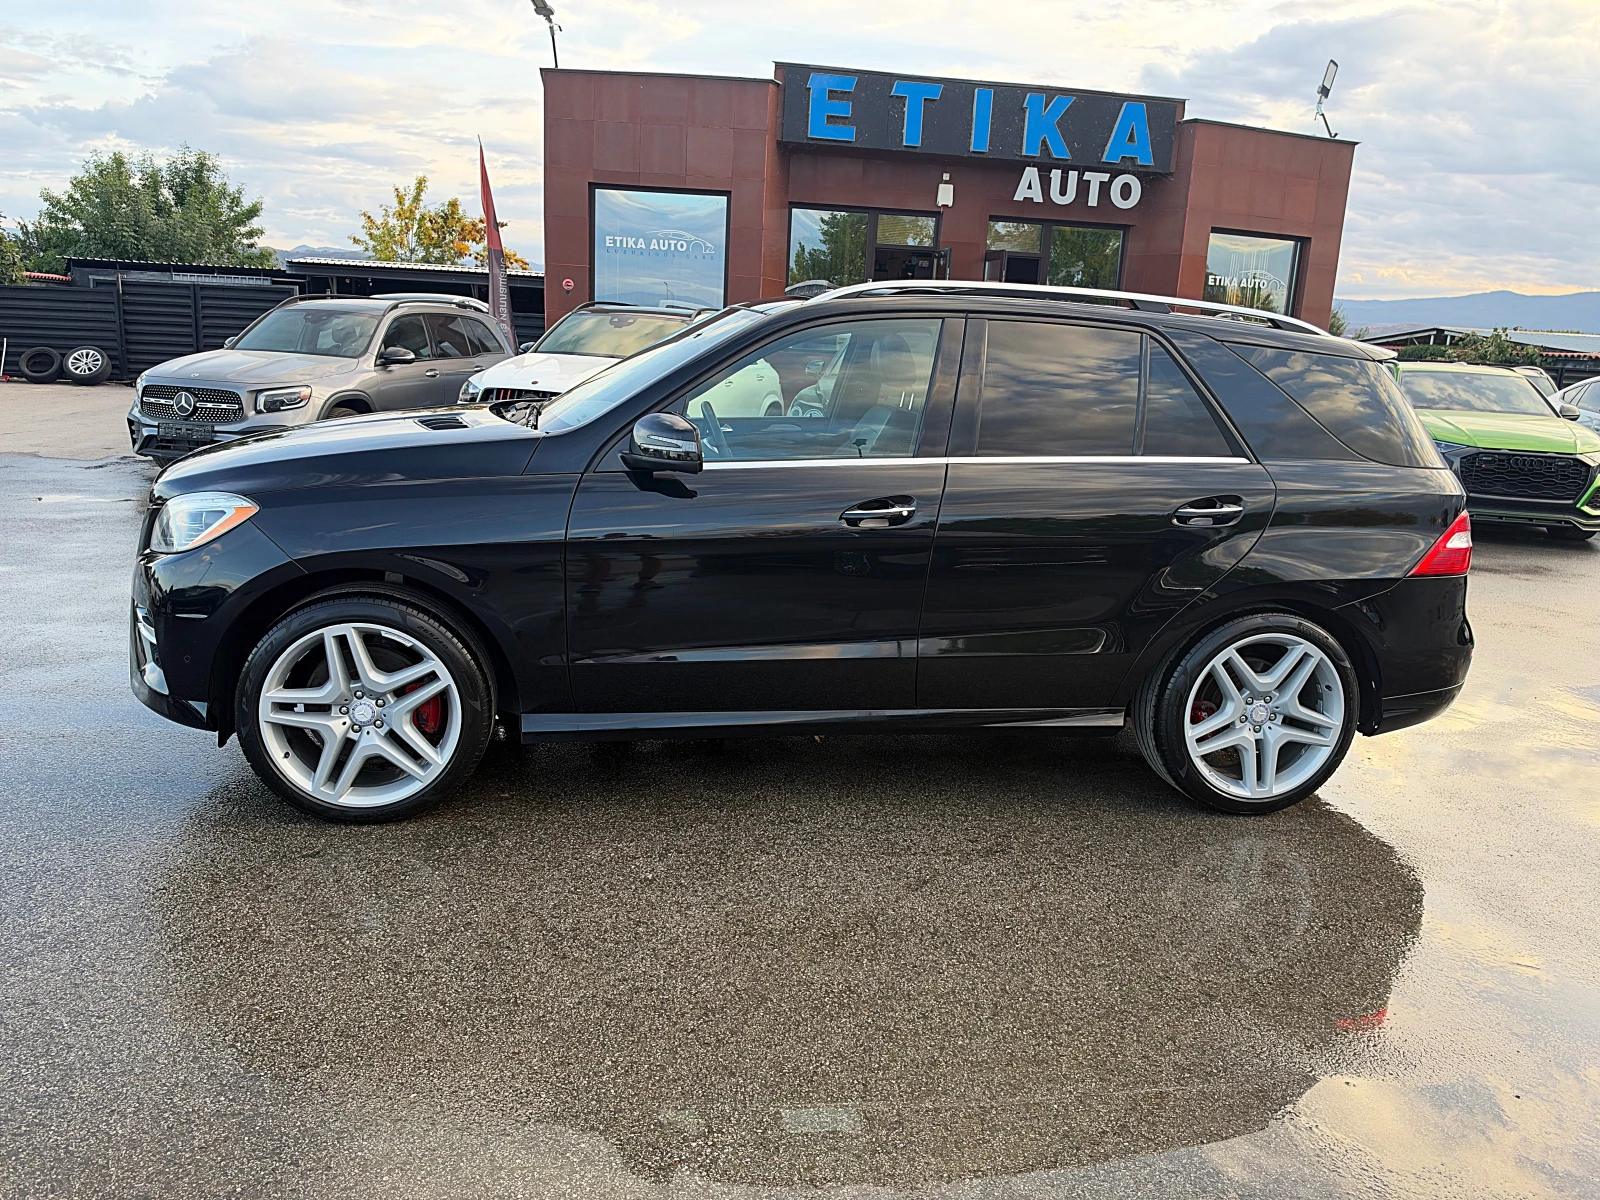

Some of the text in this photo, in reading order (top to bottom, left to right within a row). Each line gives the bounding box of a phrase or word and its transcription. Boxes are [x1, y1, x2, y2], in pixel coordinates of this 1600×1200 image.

[807, 72, 1155, 166] ETIKA
[1013, 166, 1142, 209] AUTO
[605, 235, 687, 252] ETIKA AUTO
[606, 249, 715, 261] LUXURIOUS CARS
[1208, 275, 1267, 289] ETIKA AUTO
